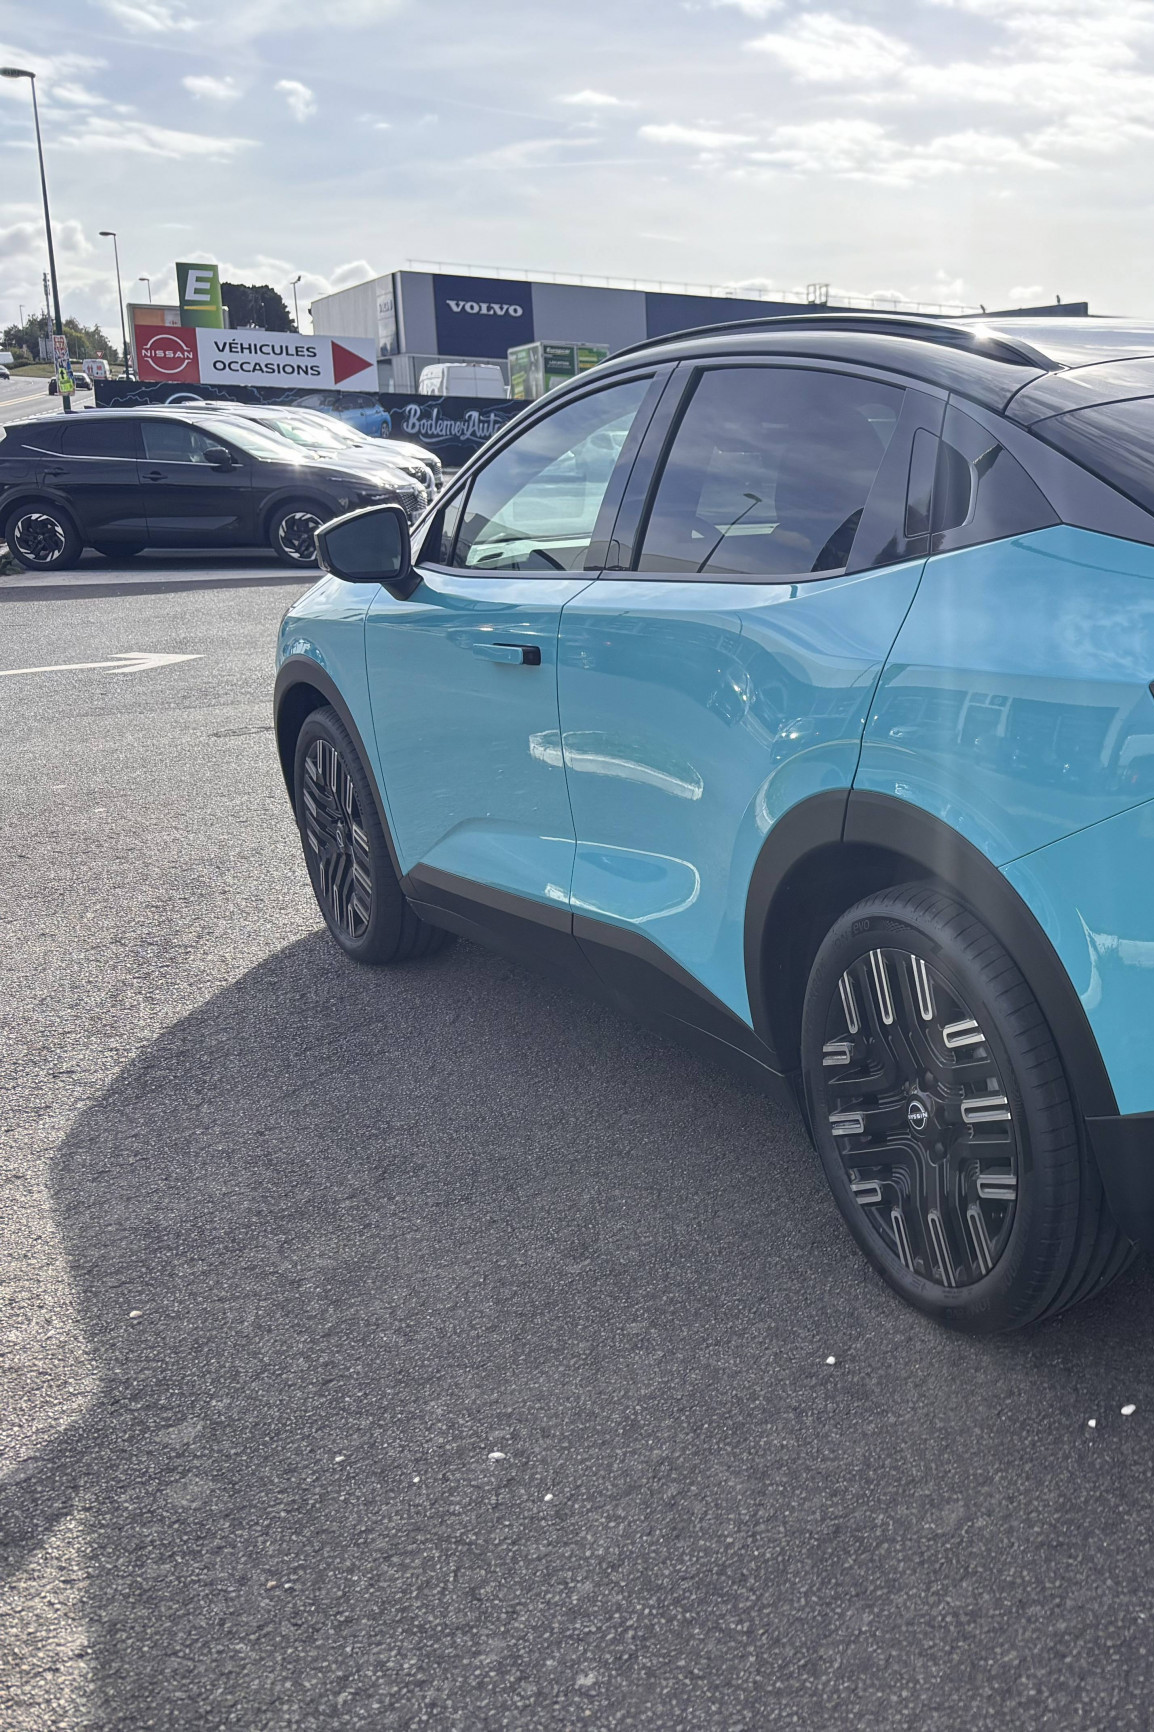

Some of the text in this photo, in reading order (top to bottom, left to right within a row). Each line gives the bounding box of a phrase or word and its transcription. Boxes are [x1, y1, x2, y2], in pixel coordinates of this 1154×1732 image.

[184, 270, 213, 301] E
[446, 300, 523, 317] VOLVO
[142, 349, 193, 359] NISSAN
[214, 339, 317, 358] VÉHICULES
[213, 360, 321, 376] OCCASIONS
